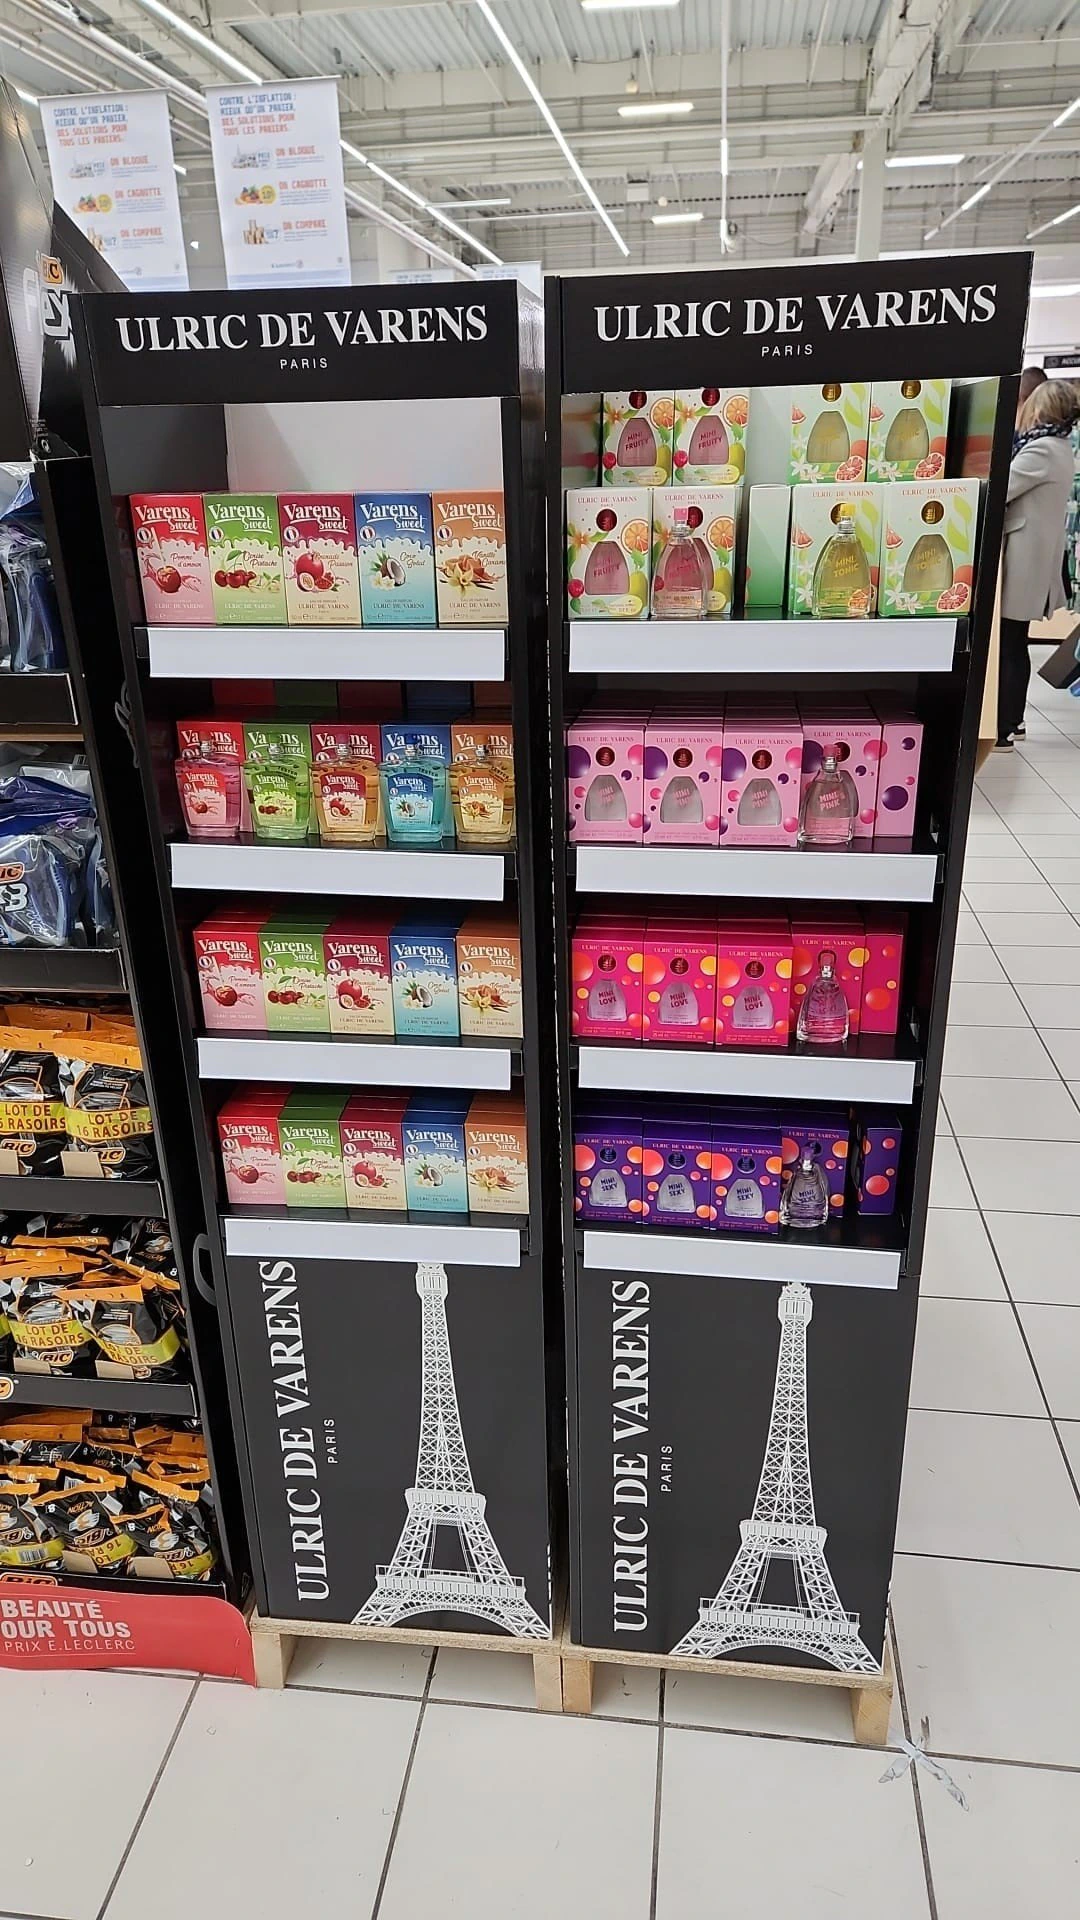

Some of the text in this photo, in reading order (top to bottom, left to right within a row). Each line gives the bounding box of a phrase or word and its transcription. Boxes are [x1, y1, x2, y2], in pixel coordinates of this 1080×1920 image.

[595, 284, 998, 342] ULRIC DE VARENS
[115, 304, 488, 352] ULRIC DE VARENS
[761, 344, 814, 357] PARIS
[279, 358, 328, 370] PARIS
[627, 431, 643, 442] MINI
[700, 430, 717, 441] MINI
[625, 438, 650, 451] FRUITY
[698, 436, 723, 449] FRUITY
[135, 504, 191, 521] Varens
[208, 503, 265, 520] Varens
[283, 504, 341, 520] Varens
[360, 502, 418, 519] Varens
[437, 502, 495, 518] Varens
[833, 566, 860, 578] TONIC
[819, 800, 840, 811] PINK
[198, 939, 247, 952] Varens
[263, 941, 312, 953] Varens
[328, 943, 377, 955] Varens
[394, 944, 444, 956] Varens
[461, 945, 510, 957] Varens
[599, 998, 617, 1006] LOVE
[670, 992, 686, 1000] MINI
[670, 999, 688, 1008] LOVE
[744, 1002, 764, 1011] LOVE
[5, 1104, 51, 1116] LOT DE
[9, 1117, 66, 1131] RASOIRS
[88, 1111, 139, 1125] LOT DE
[77, 1121, 153, 1138] 16 RASOIRS
[222, 1124, 268, 1135] Varens
[282, 1127, 329, 1138] Varens
[344, 1128, 391, 1140] Varens
[406, 1130, 453, 1142] Varens
[469, 1131, 516, 1143] Varens
[600, 1183, 618, 1192] SEXY
[668, 1189, 686, 1197] SEXY
[736, 1193, 754, 1201] SEXY
[170, 1268, 178, 1276] 8
[26, 1323, 69, 1336] LOT DE
[31, 1333, 85, 1346] RASOIRS
[126, 1345, 143, 1355] DE
[40, 1353, 70, 1362] BIC
[259, 1260, 332, 1601] ULRIC DE VARENS
[324, 1418, 339, 1464] PARIS
[611, 1280, 650, 1633] ULRIC DE VARENS
[661, 1444, 674, 1492] PARIS
[48, 1504, 56, 1513] 8
[1, 1599, 104, 1620] BEAUTÉ
[63, 1620, 131, 1639] TOUS
[4, 1639, 136, 1652] PRIX E.LECLERC
